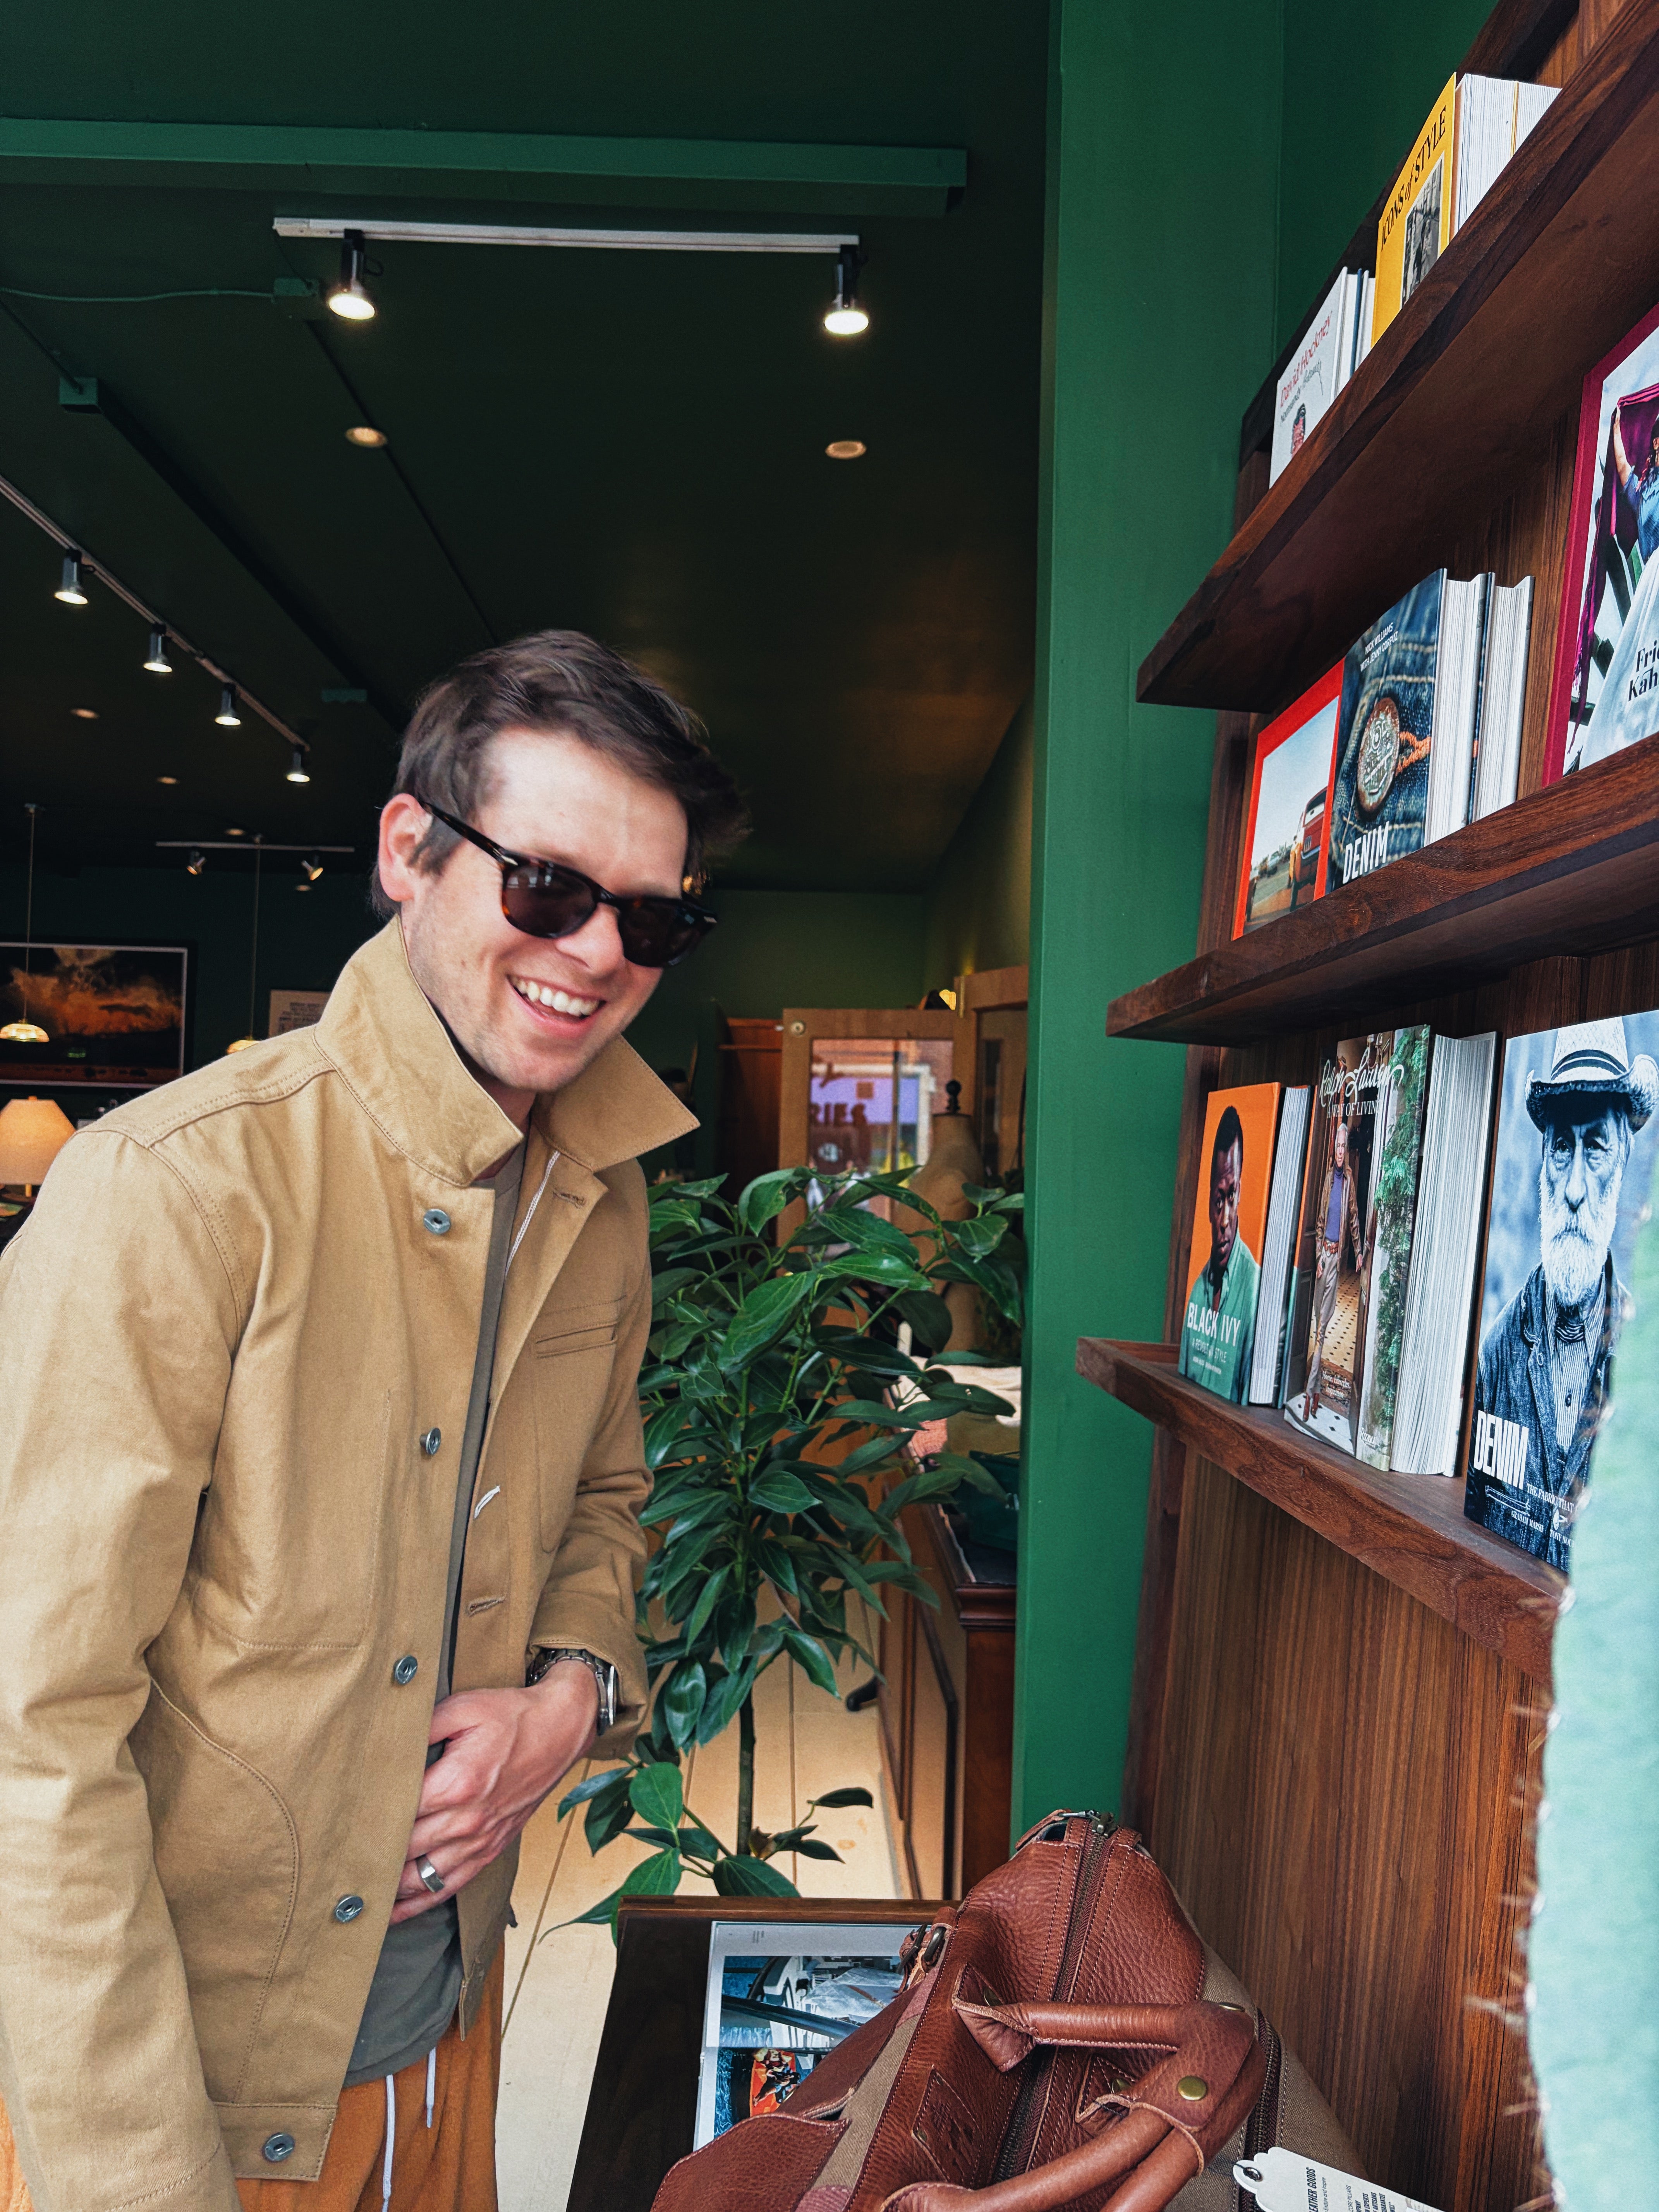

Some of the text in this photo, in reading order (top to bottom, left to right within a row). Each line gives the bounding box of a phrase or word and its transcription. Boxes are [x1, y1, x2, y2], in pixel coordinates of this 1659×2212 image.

[1381, 105, 1446, 252] ICONS of STYLE
[1360, 631, 1398, 672] WITH JENNY CORPUZ
[1365, 622, 1393, 655] NICK WILLIAMS
[1636, 640, 1659, 673] Fri
[1343, 821, 1389, 884] DENIM
[1319, 1047, 1405, 1108] Ralph Lauren
[1332, 1103, 1345, 1117] WAY
[1345, 1102, 1356, 1116] OF
[1356, 1100, 1379, 1115] LIVIN
[1187, 1302, 1241, 1346] BLACK IVY
[1474, 1410, 1529, 1490] DENIM
[1527, 1483, 1537, 1497] THE
[1558, 1498, 1574, 1513] THAT
[1511, 1510, 1544, 1533] GRAHAM MARSH
[1550, 1529, 1562, 1542] TONY
[1306, 2167, 1319, 2212] EATHER GOODS
